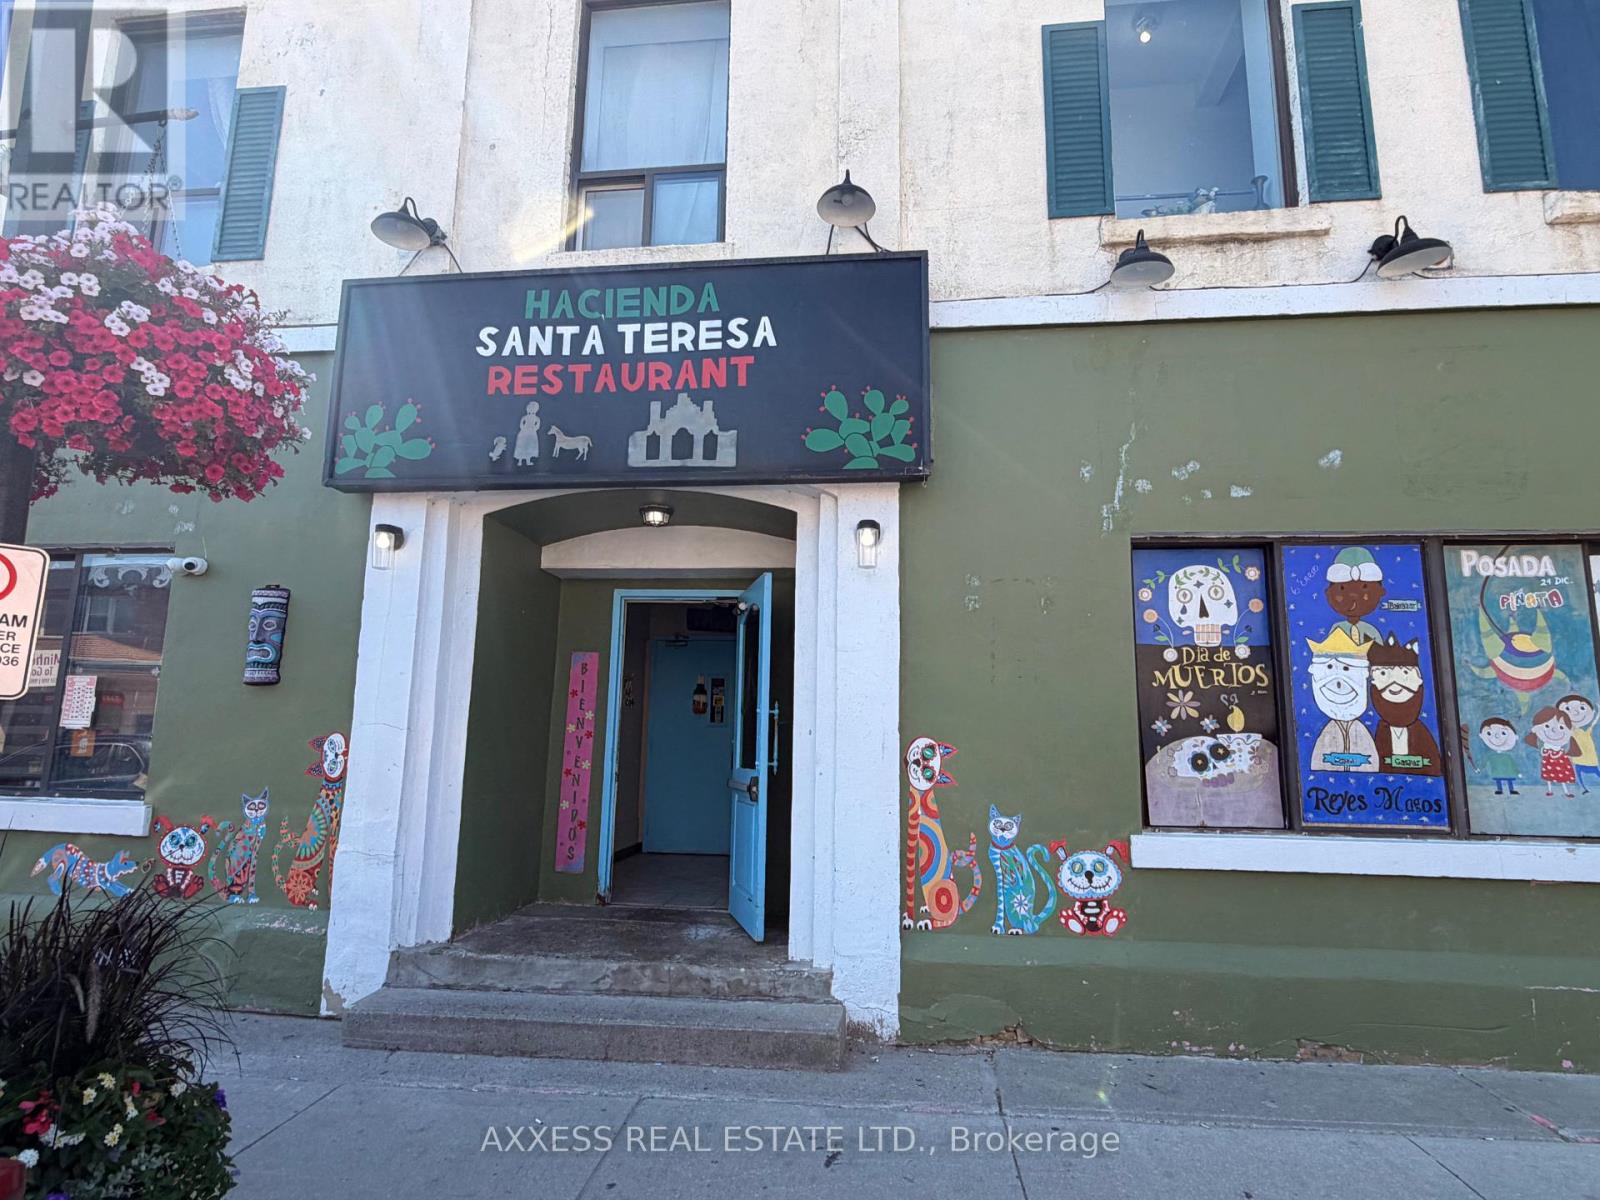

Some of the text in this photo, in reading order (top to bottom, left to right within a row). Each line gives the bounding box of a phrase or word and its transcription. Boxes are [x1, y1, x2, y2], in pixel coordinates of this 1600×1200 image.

[525, 282, 720, 319] HACIENDA
[476, 316, 777, 357] SANTA TERESA
[487, 356, 755, 395] RESTAURANT
[1460, 549, 1557, 577] POSADA
[1213, 647, 1231, 662] de
[1152, 662, 1269, 689] MUERTOS
[567, 662, 589, 861] BIENVENIDOS
[1307, 787, 1368, 815] Reyes
